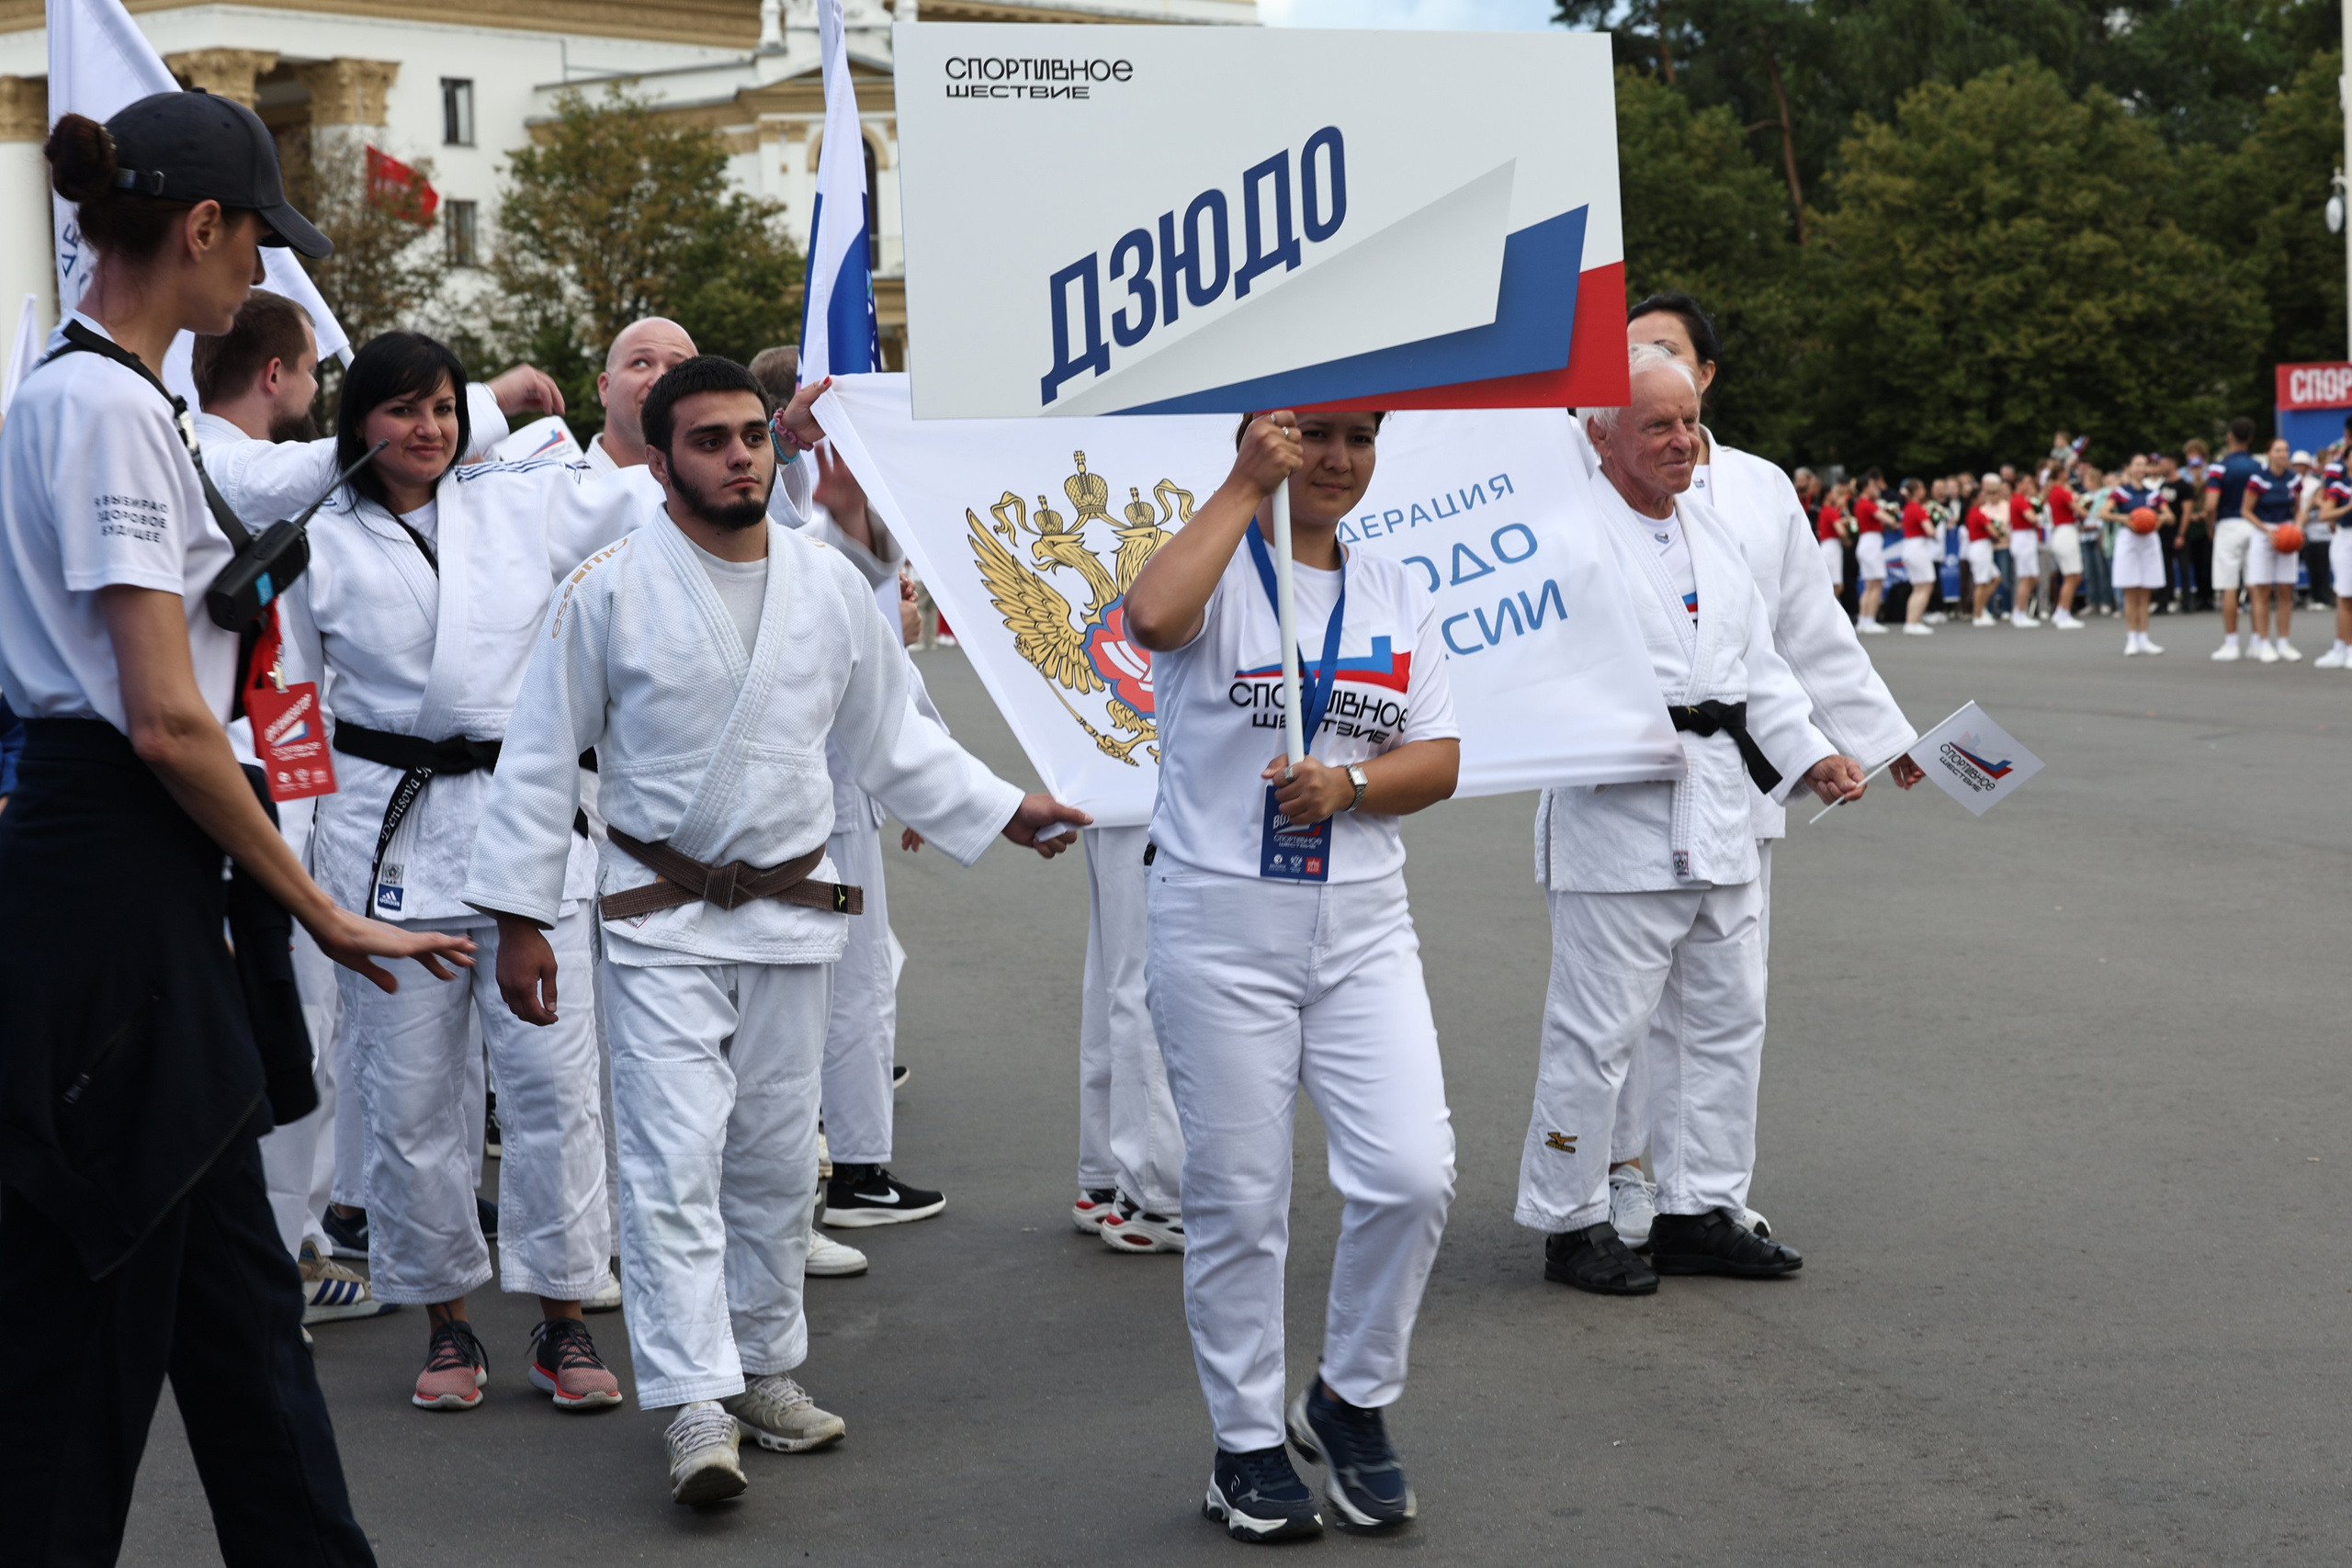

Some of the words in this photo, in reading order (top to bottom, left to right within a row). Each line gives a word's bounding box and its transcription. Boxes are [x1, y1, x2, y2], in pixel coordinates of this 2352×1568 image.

[946, 85, 1090, 99] ШЕСТВИЕ
[1041, 126, 1346, 406] ДЗЮДО
[1338, 473, 1514, 543] ДЕРАЦИЯ
[1441, 579, 1568, 660] СИИ
[381, 778, 420, 841] Denisova
